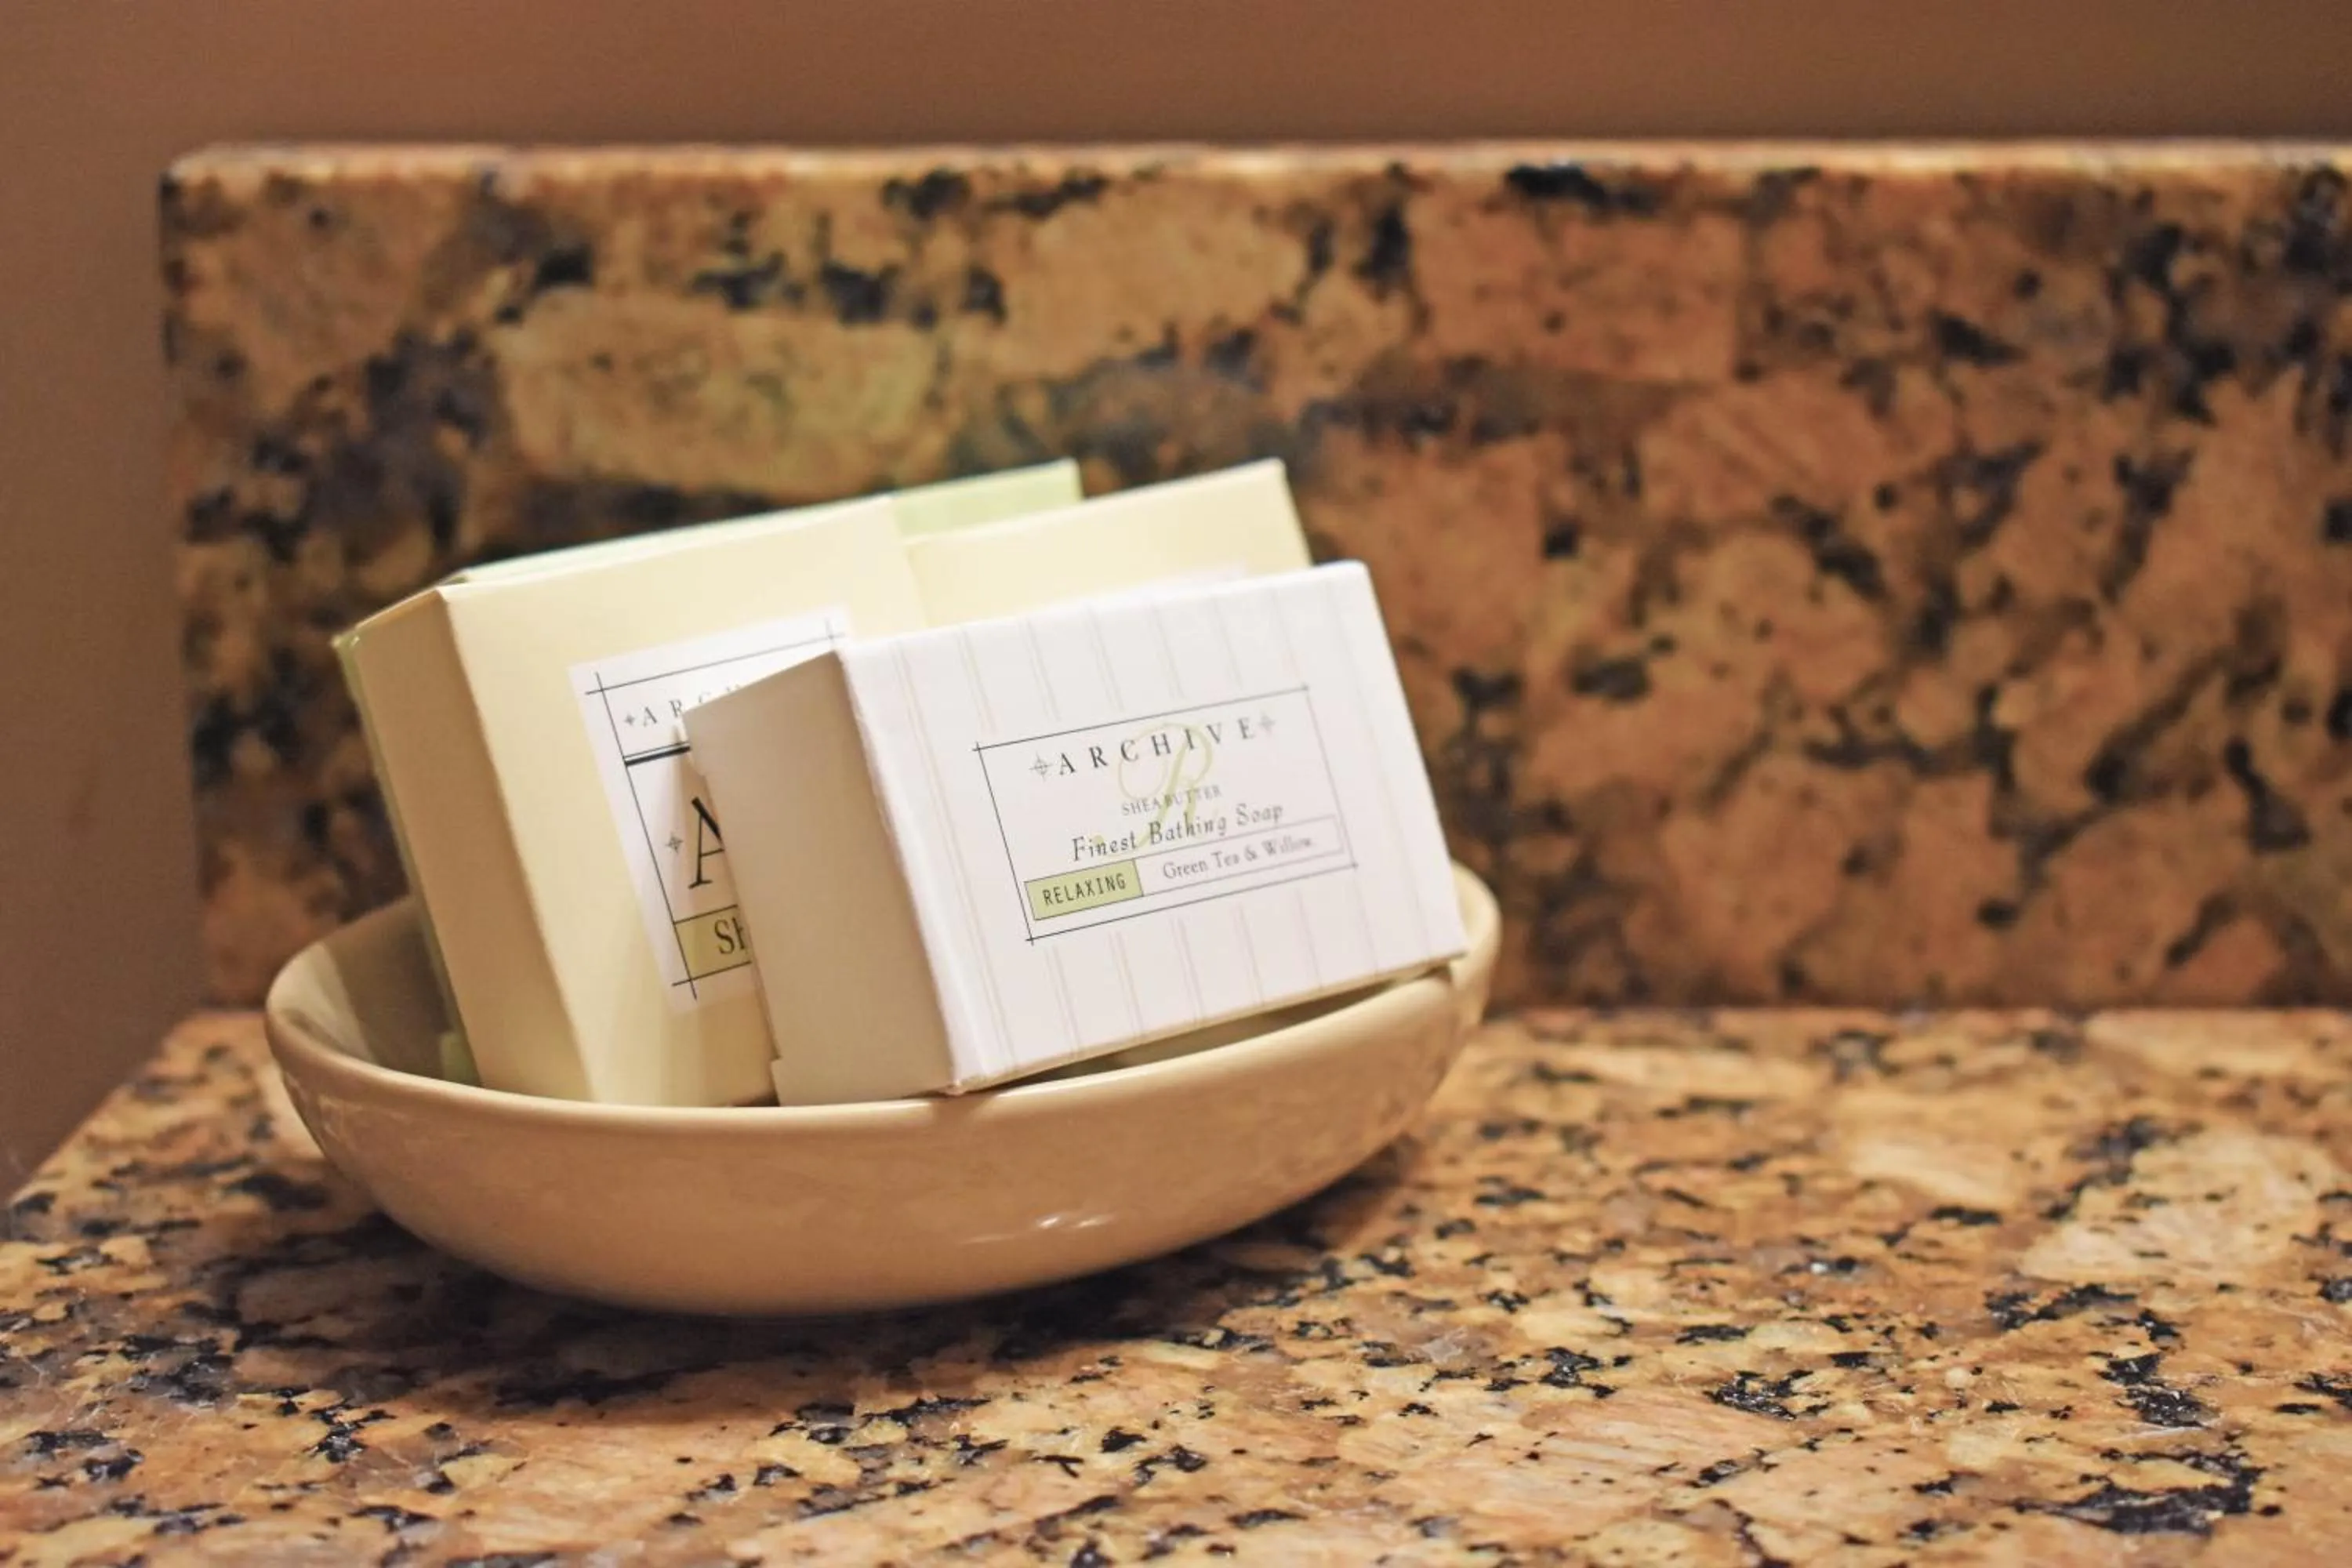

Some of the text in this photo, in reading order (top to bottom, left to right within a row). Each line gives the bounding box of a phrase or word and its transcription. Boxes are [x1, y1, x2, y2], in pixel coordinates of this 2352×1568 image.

[1058, 717, 1257, 775] ARCHIVE
[1071, 802, 1284, 862] Finest Bathing Soap
[1163, 858, 1208, 880] Green
[1214, 851, 1240, 869] Tea
[1243, 844, 1258, 862] &
[1041, 872, 1127, 906] RELAXING
